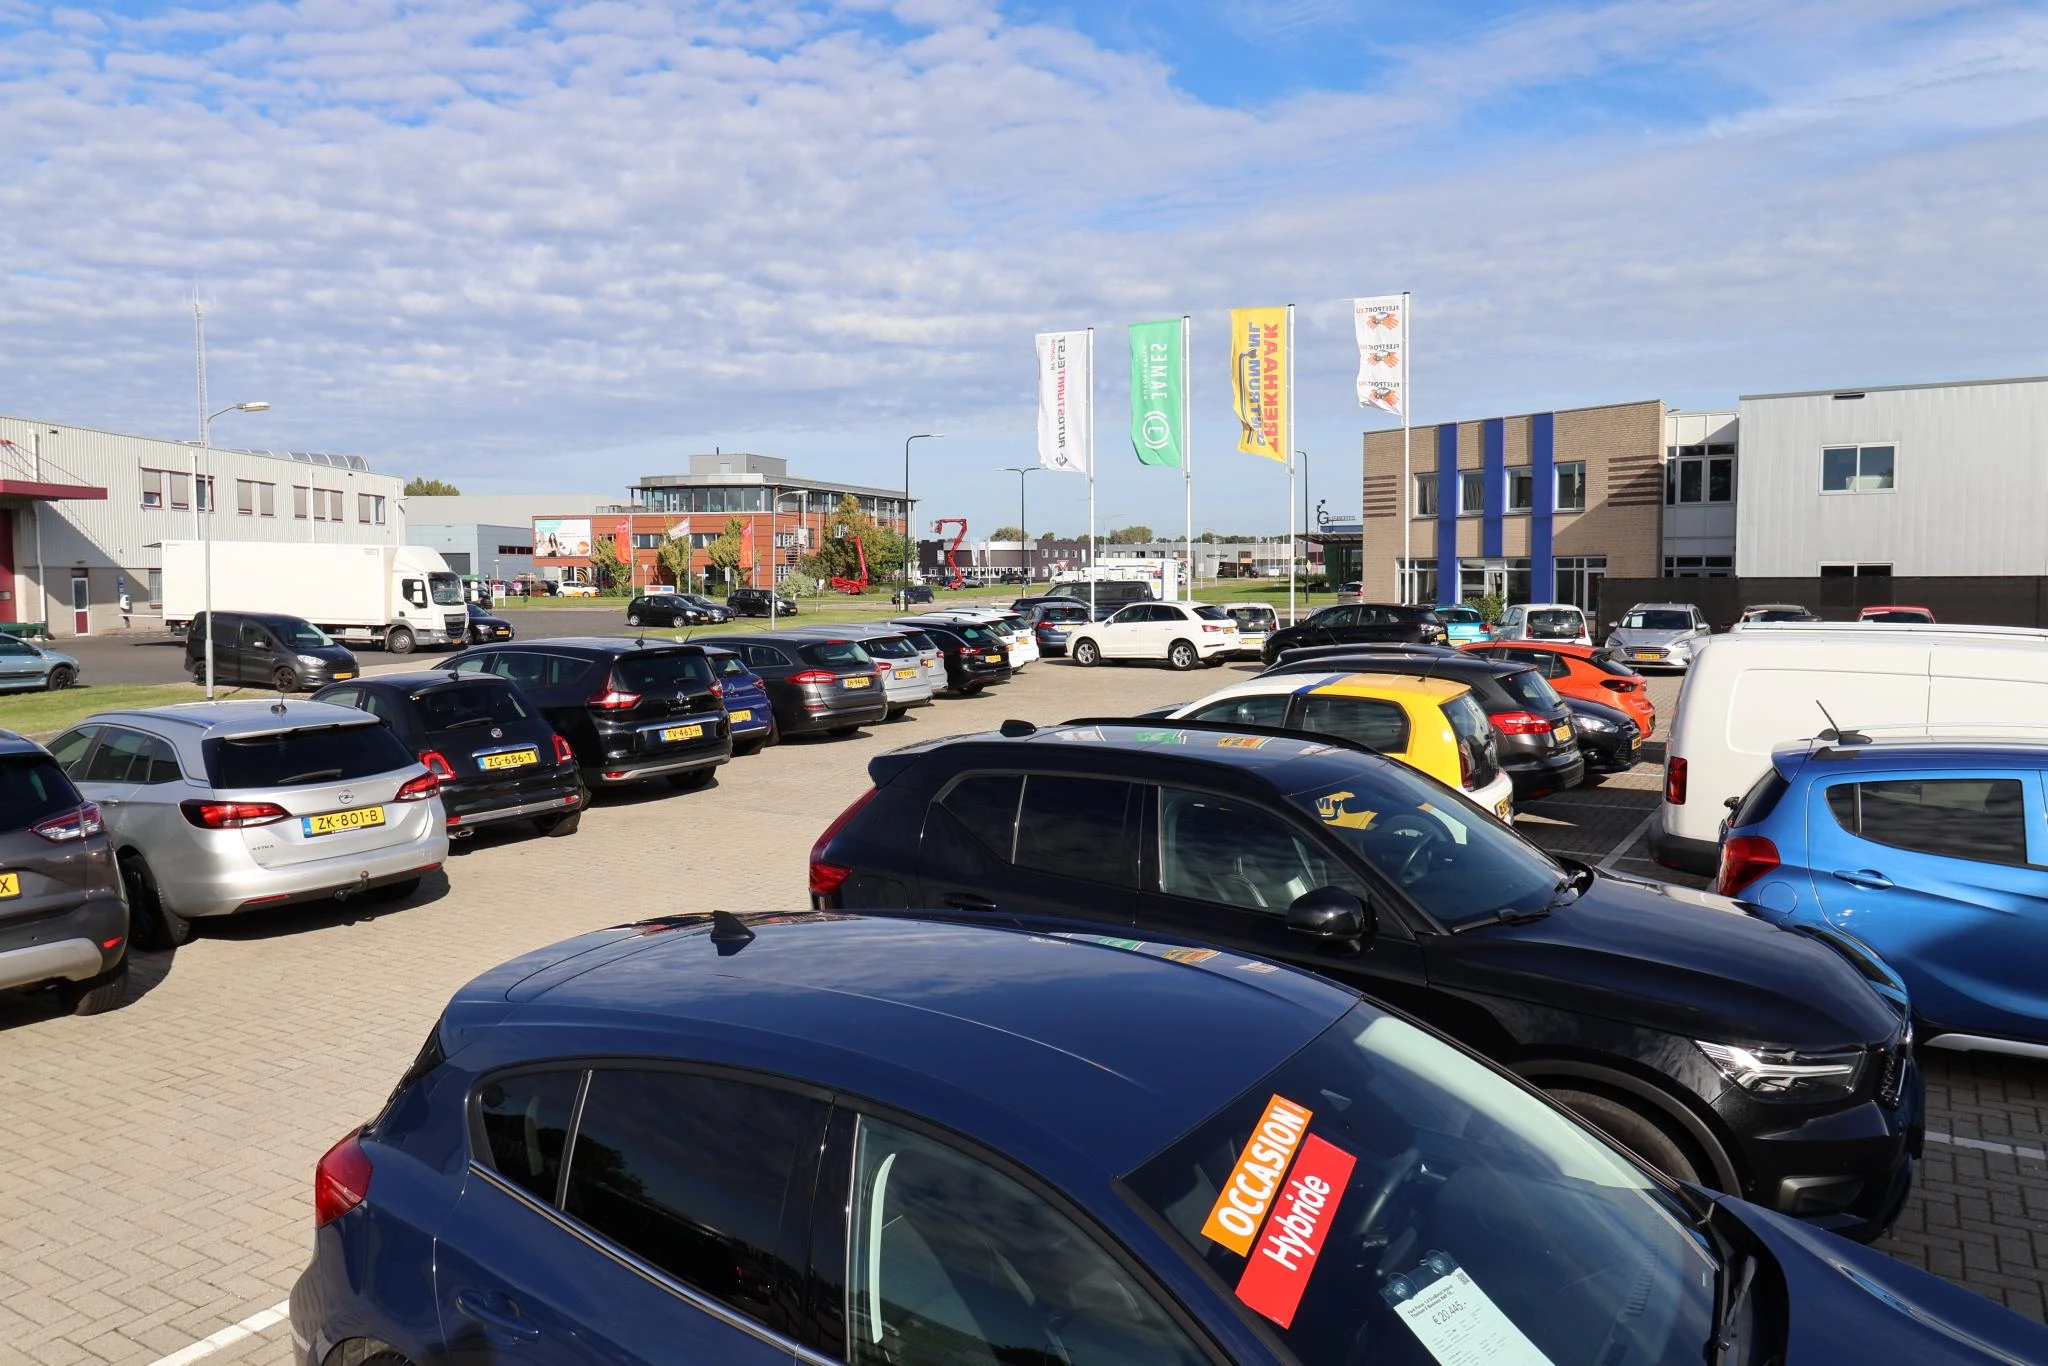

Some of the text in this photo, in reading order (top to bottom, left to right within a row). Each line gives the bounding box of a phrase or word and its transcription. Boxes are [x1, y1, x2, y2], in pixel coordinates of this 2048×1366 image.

[667, 727, 700, 738] TV-463-H
[487, 752, 532, 767] ZG-686-T
[317, 810, 378, 830] ZK-801-B
[1218, 1105, 1305, 1236] OCCASION
[1262, 1175, 1331, 1271] Hybride
[1432, 1314, 1441, 1325] €
